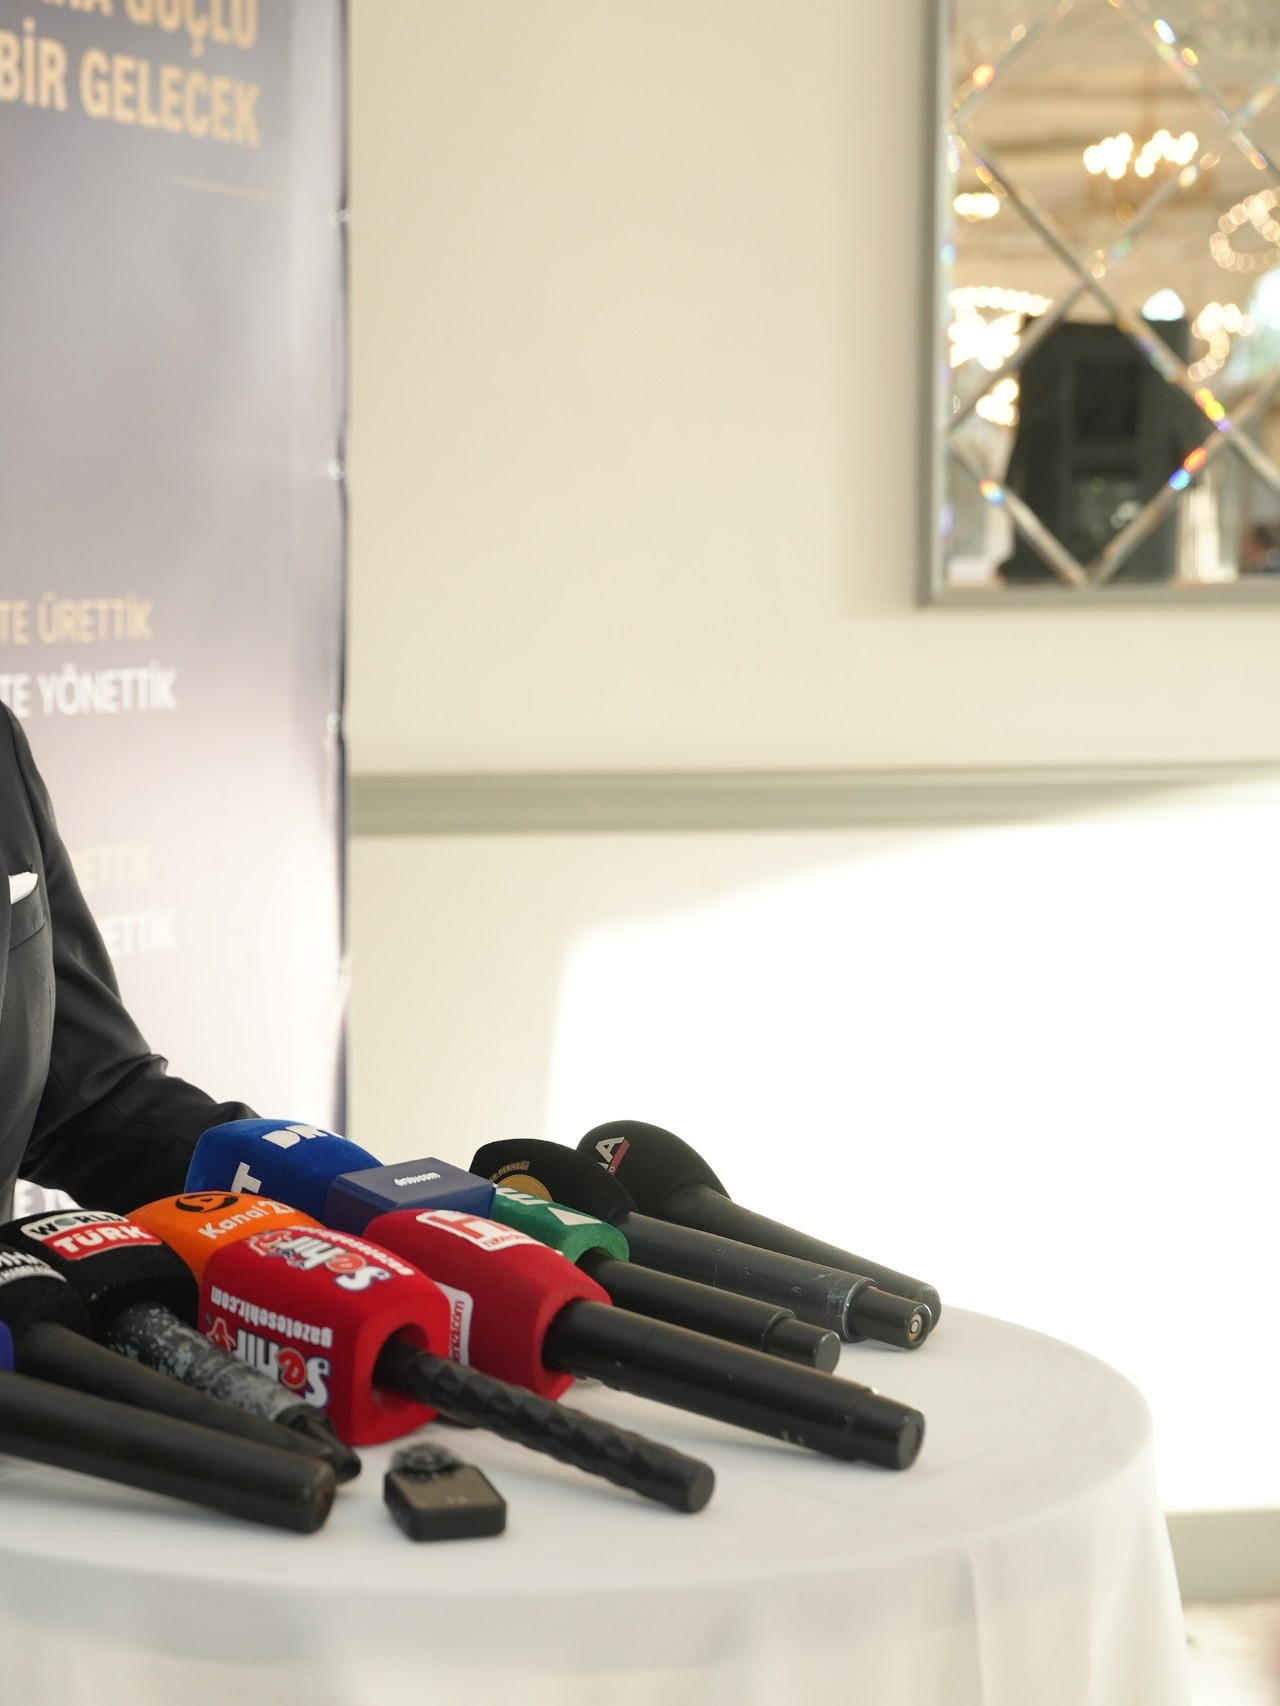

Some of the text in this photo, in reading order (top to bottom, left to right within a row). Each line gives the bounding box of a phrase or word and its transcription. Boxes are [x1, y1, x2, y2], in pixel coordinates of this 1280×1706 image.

[79, 47, 261, 149] GELECEK
[37, 590, 155, 645] ÜRETTİK
[37, 660, 178, 716] YÖNETTİK
[53, 1223, 153, 1254] TÜRK
[198, 1205, 269, 1240] Kanal
[211, 1285, 333, 1348] gazetesehir.com
